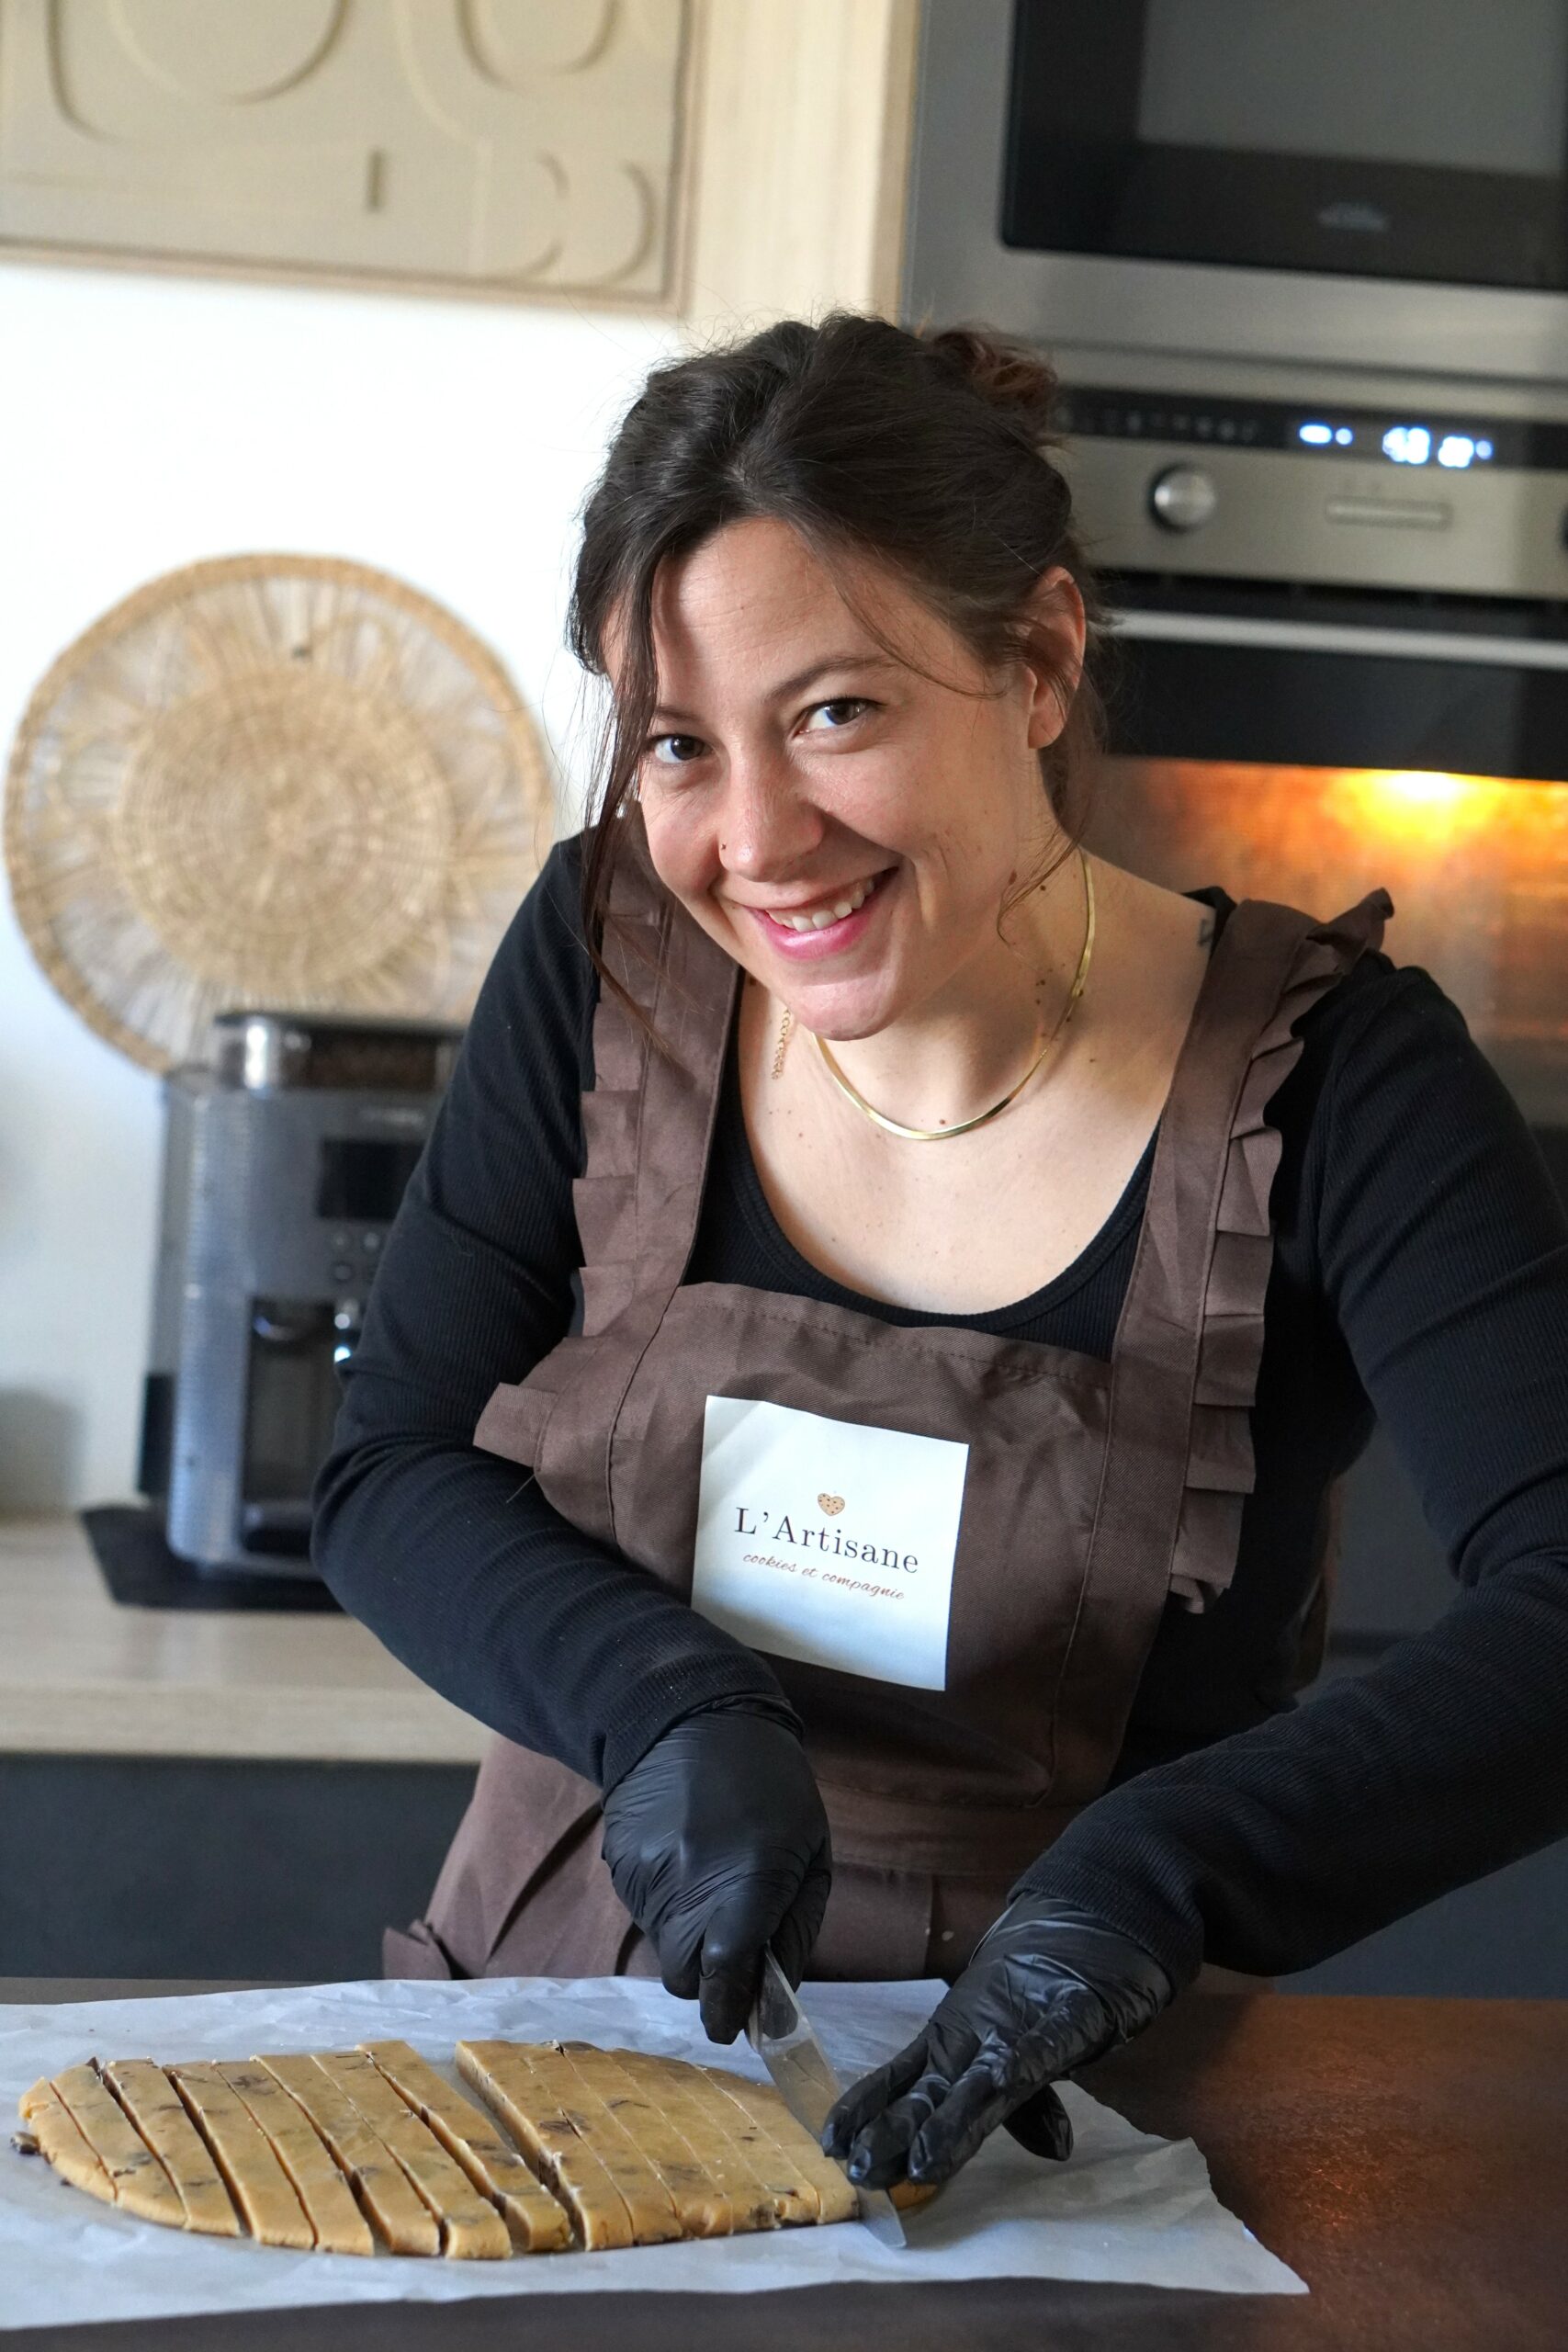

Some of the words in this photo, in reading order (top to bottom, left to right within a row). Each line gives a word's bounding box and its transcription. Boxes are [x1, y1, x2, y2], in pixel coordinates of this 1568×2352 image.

[735, 1507, 919, 1574] L'Artisane
[743, 1553, 797, 1573] cookies
[801, 1566, 818, 1578] et
[821, 1571, 905, 1600] compagnie
